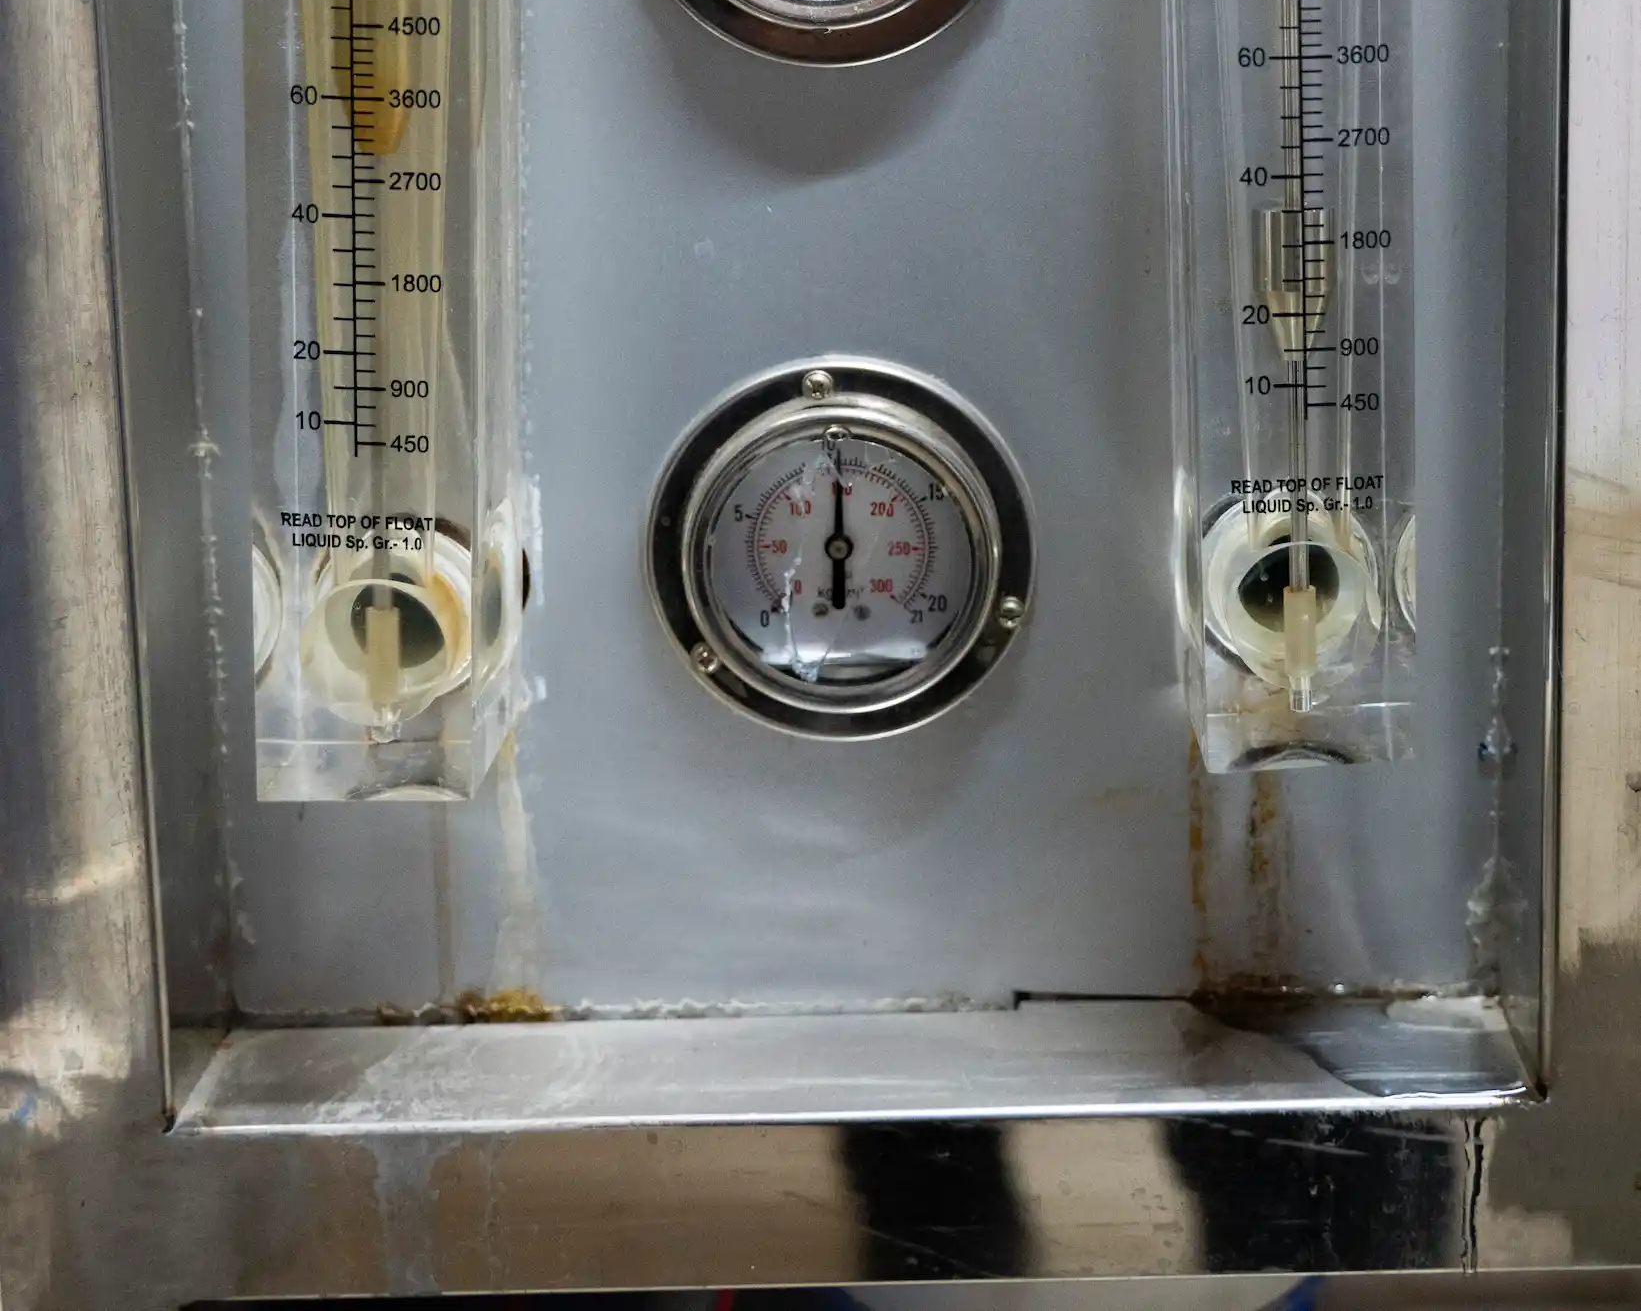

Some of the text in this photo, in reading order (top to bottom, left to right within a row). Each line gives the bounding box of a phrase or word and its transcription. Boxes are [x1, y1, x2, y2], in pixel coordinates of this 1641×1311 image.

[388, 17, 441, 36] 4500
[1238, 47, 1265, 67] 60
[1337, 44, 1389, 65] 3600
[290, 85, 317, 105] 60
[388, 89, 441, 109] 3600
[1337, 127, 1390, 147] 2700
[388, 171, 441, 191] 2700
[1239, 167, 1267, 187] 40
[291, 204, 319, 224] 40
[1340, 230, 1391, 249] 1800
[391, 274, 442, 293] 1800
[1242, 304, 1270, 324] 20
[293, 340, 321, 360] 20
[1340, 337, 1379, 356] 900
[390, 380, 429, 398] 900
[1245, 375, 1271, 395] 10
[1340, 393, 1379, 411] 450
[296, 411, 321, 430] 10
[390, 435, 429, 453] 450
[832, 481, 853, 496] 10
[929, 483, 944, 501] 15
[1231, 475, 1384, 494] READ TOP OF FLOAT
[734, 504, 743, 522] 5
[870, 502, 894, 517] 200
[1243, 499, 1291, 514] LIQUID
[1296, 498, 1319, 516] Sp.
[1353, 496, 1373, 510] 1.0
[281, 512, 433, 532] READ TOP OF FLOAT
[292, 533, 341, 548] LIQUID
[346, 534, 368, 551] Sp.
[404, 537, 422, 551] 1.0
[770, 541, 787, 556] 50
[888, 541, 911, 556] 250
[870, 578, 893, 593] 300
[928, 593, 947, 612] 20
[760, 610, 769, 627] 0
[909, 609, 923, 624] 21
